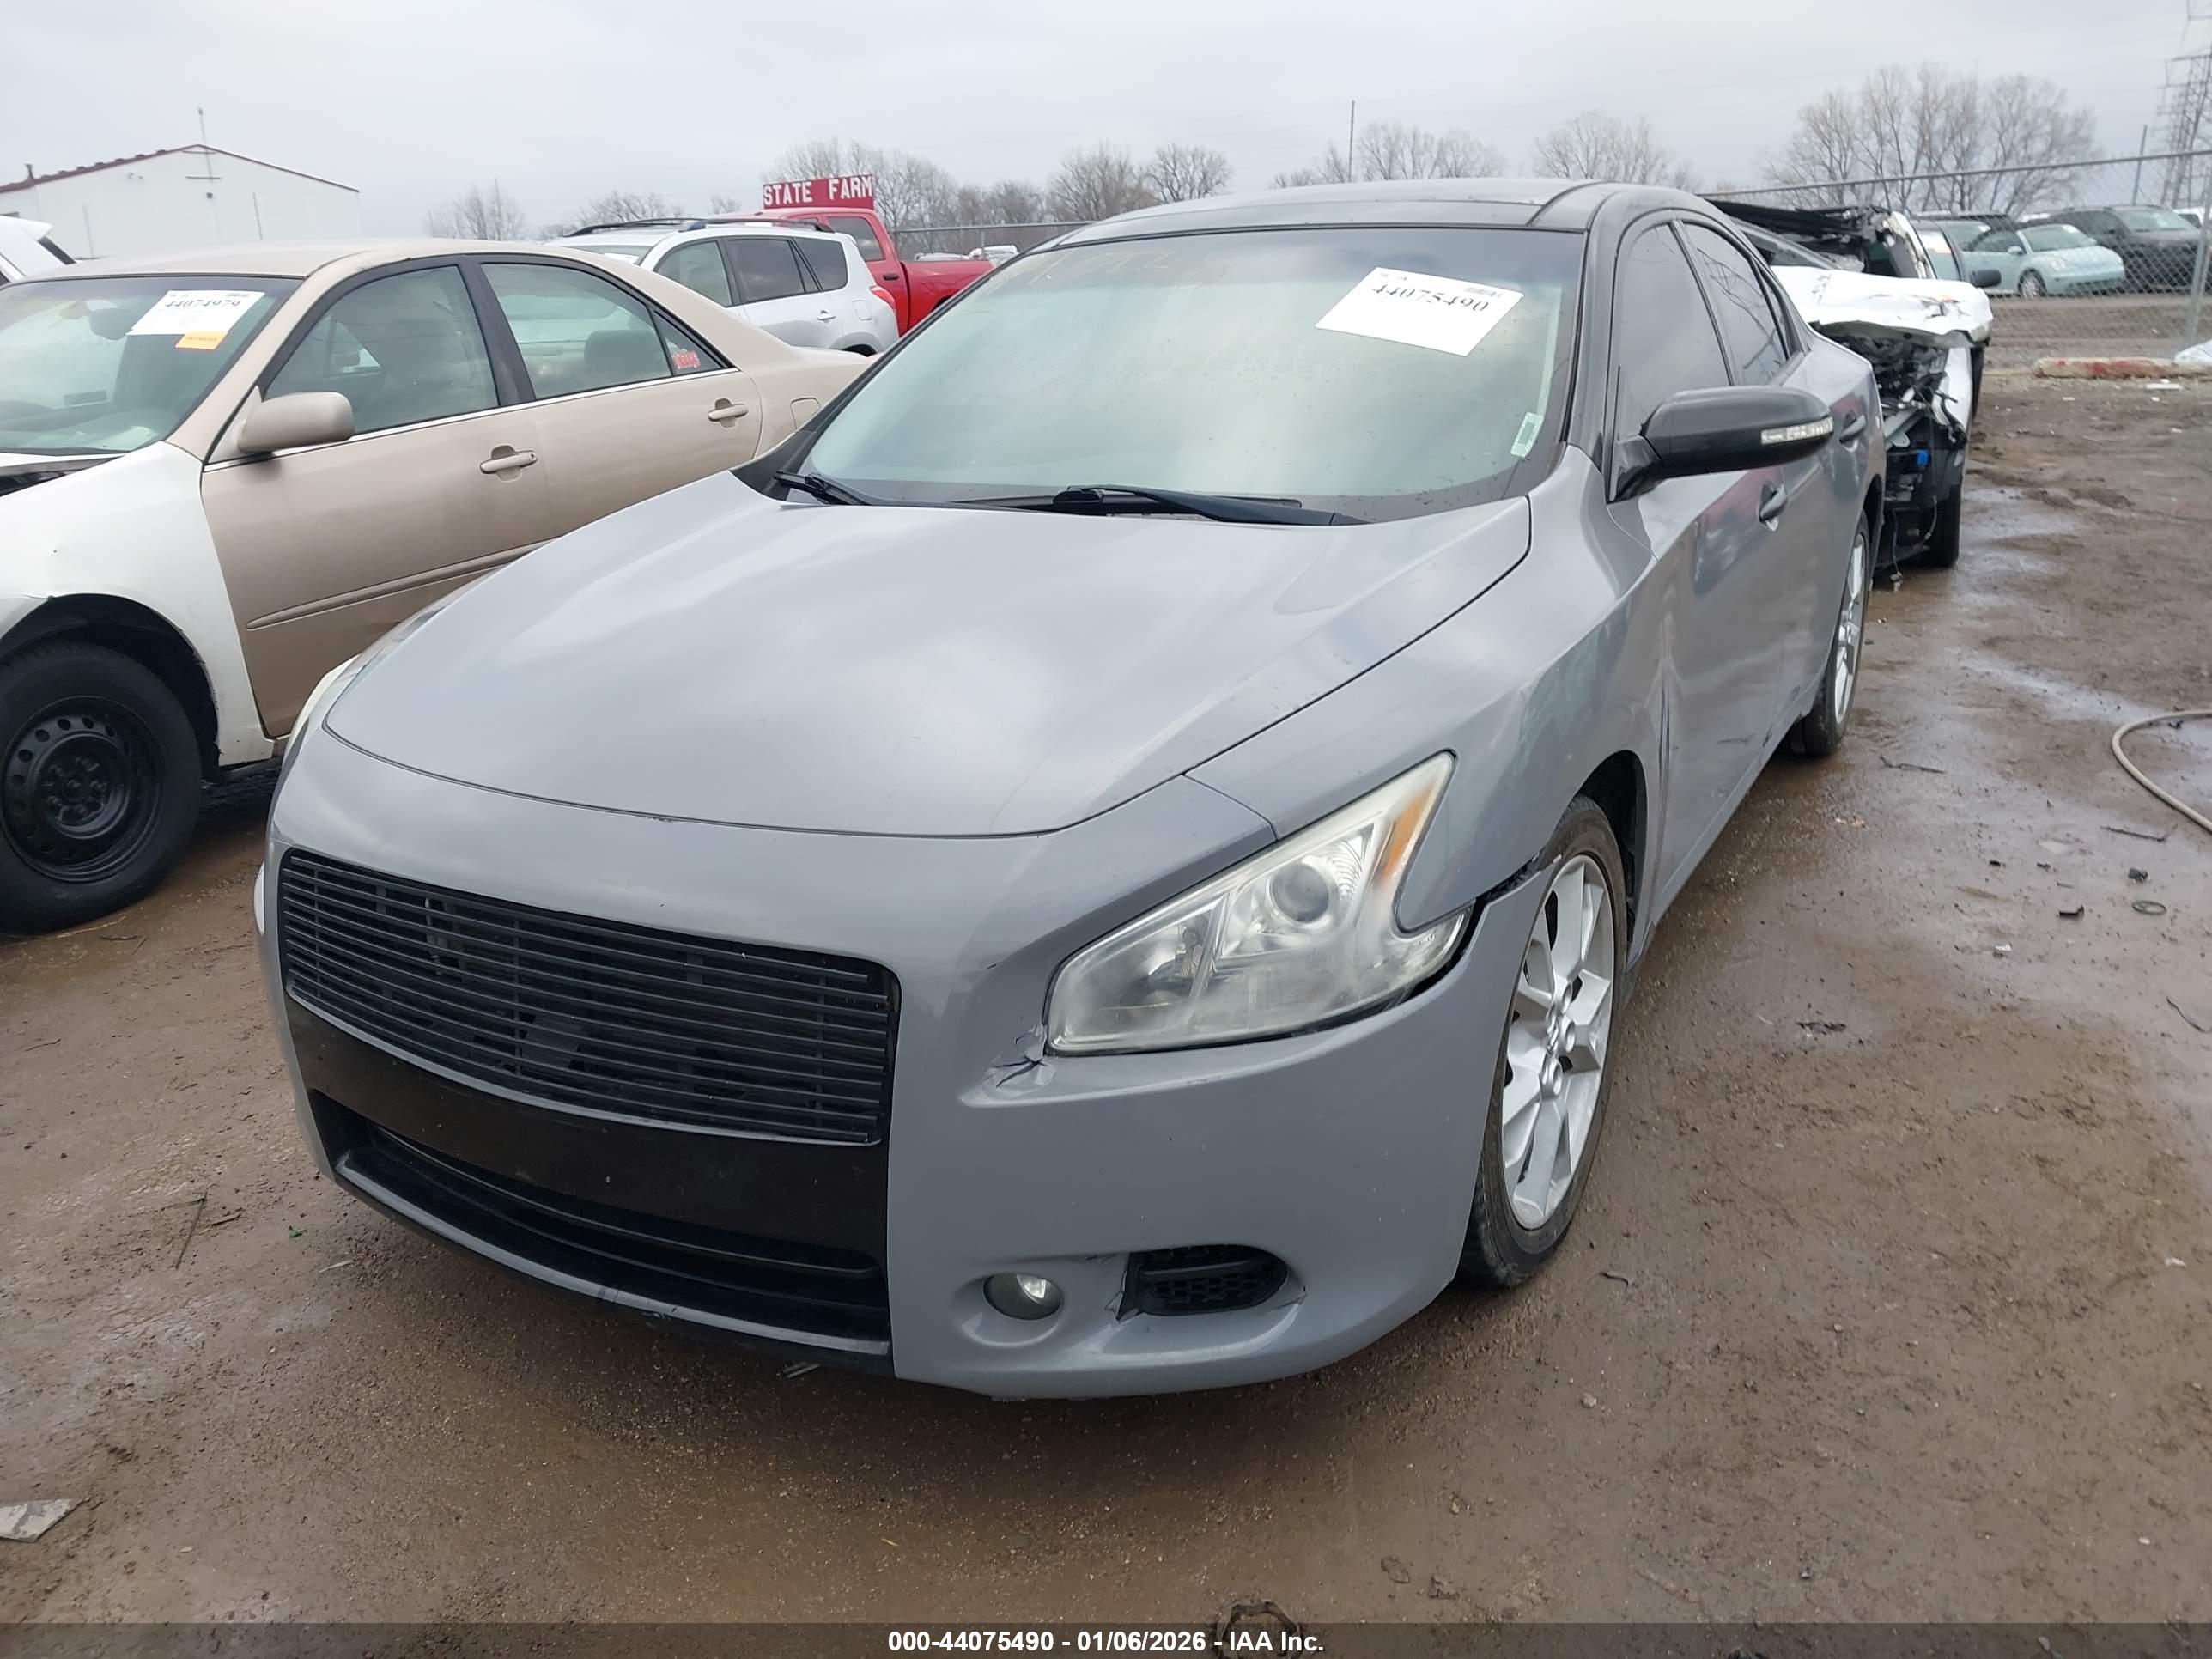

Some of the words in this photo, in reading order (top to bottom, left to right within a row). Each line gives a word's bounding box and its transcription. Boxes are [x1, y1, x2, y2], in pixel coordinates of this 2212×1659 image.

[763, 181, 812, 205] STATE
[829, 176, 872, 199] FARM
[1371, 284, 1489, 312] 44075490
